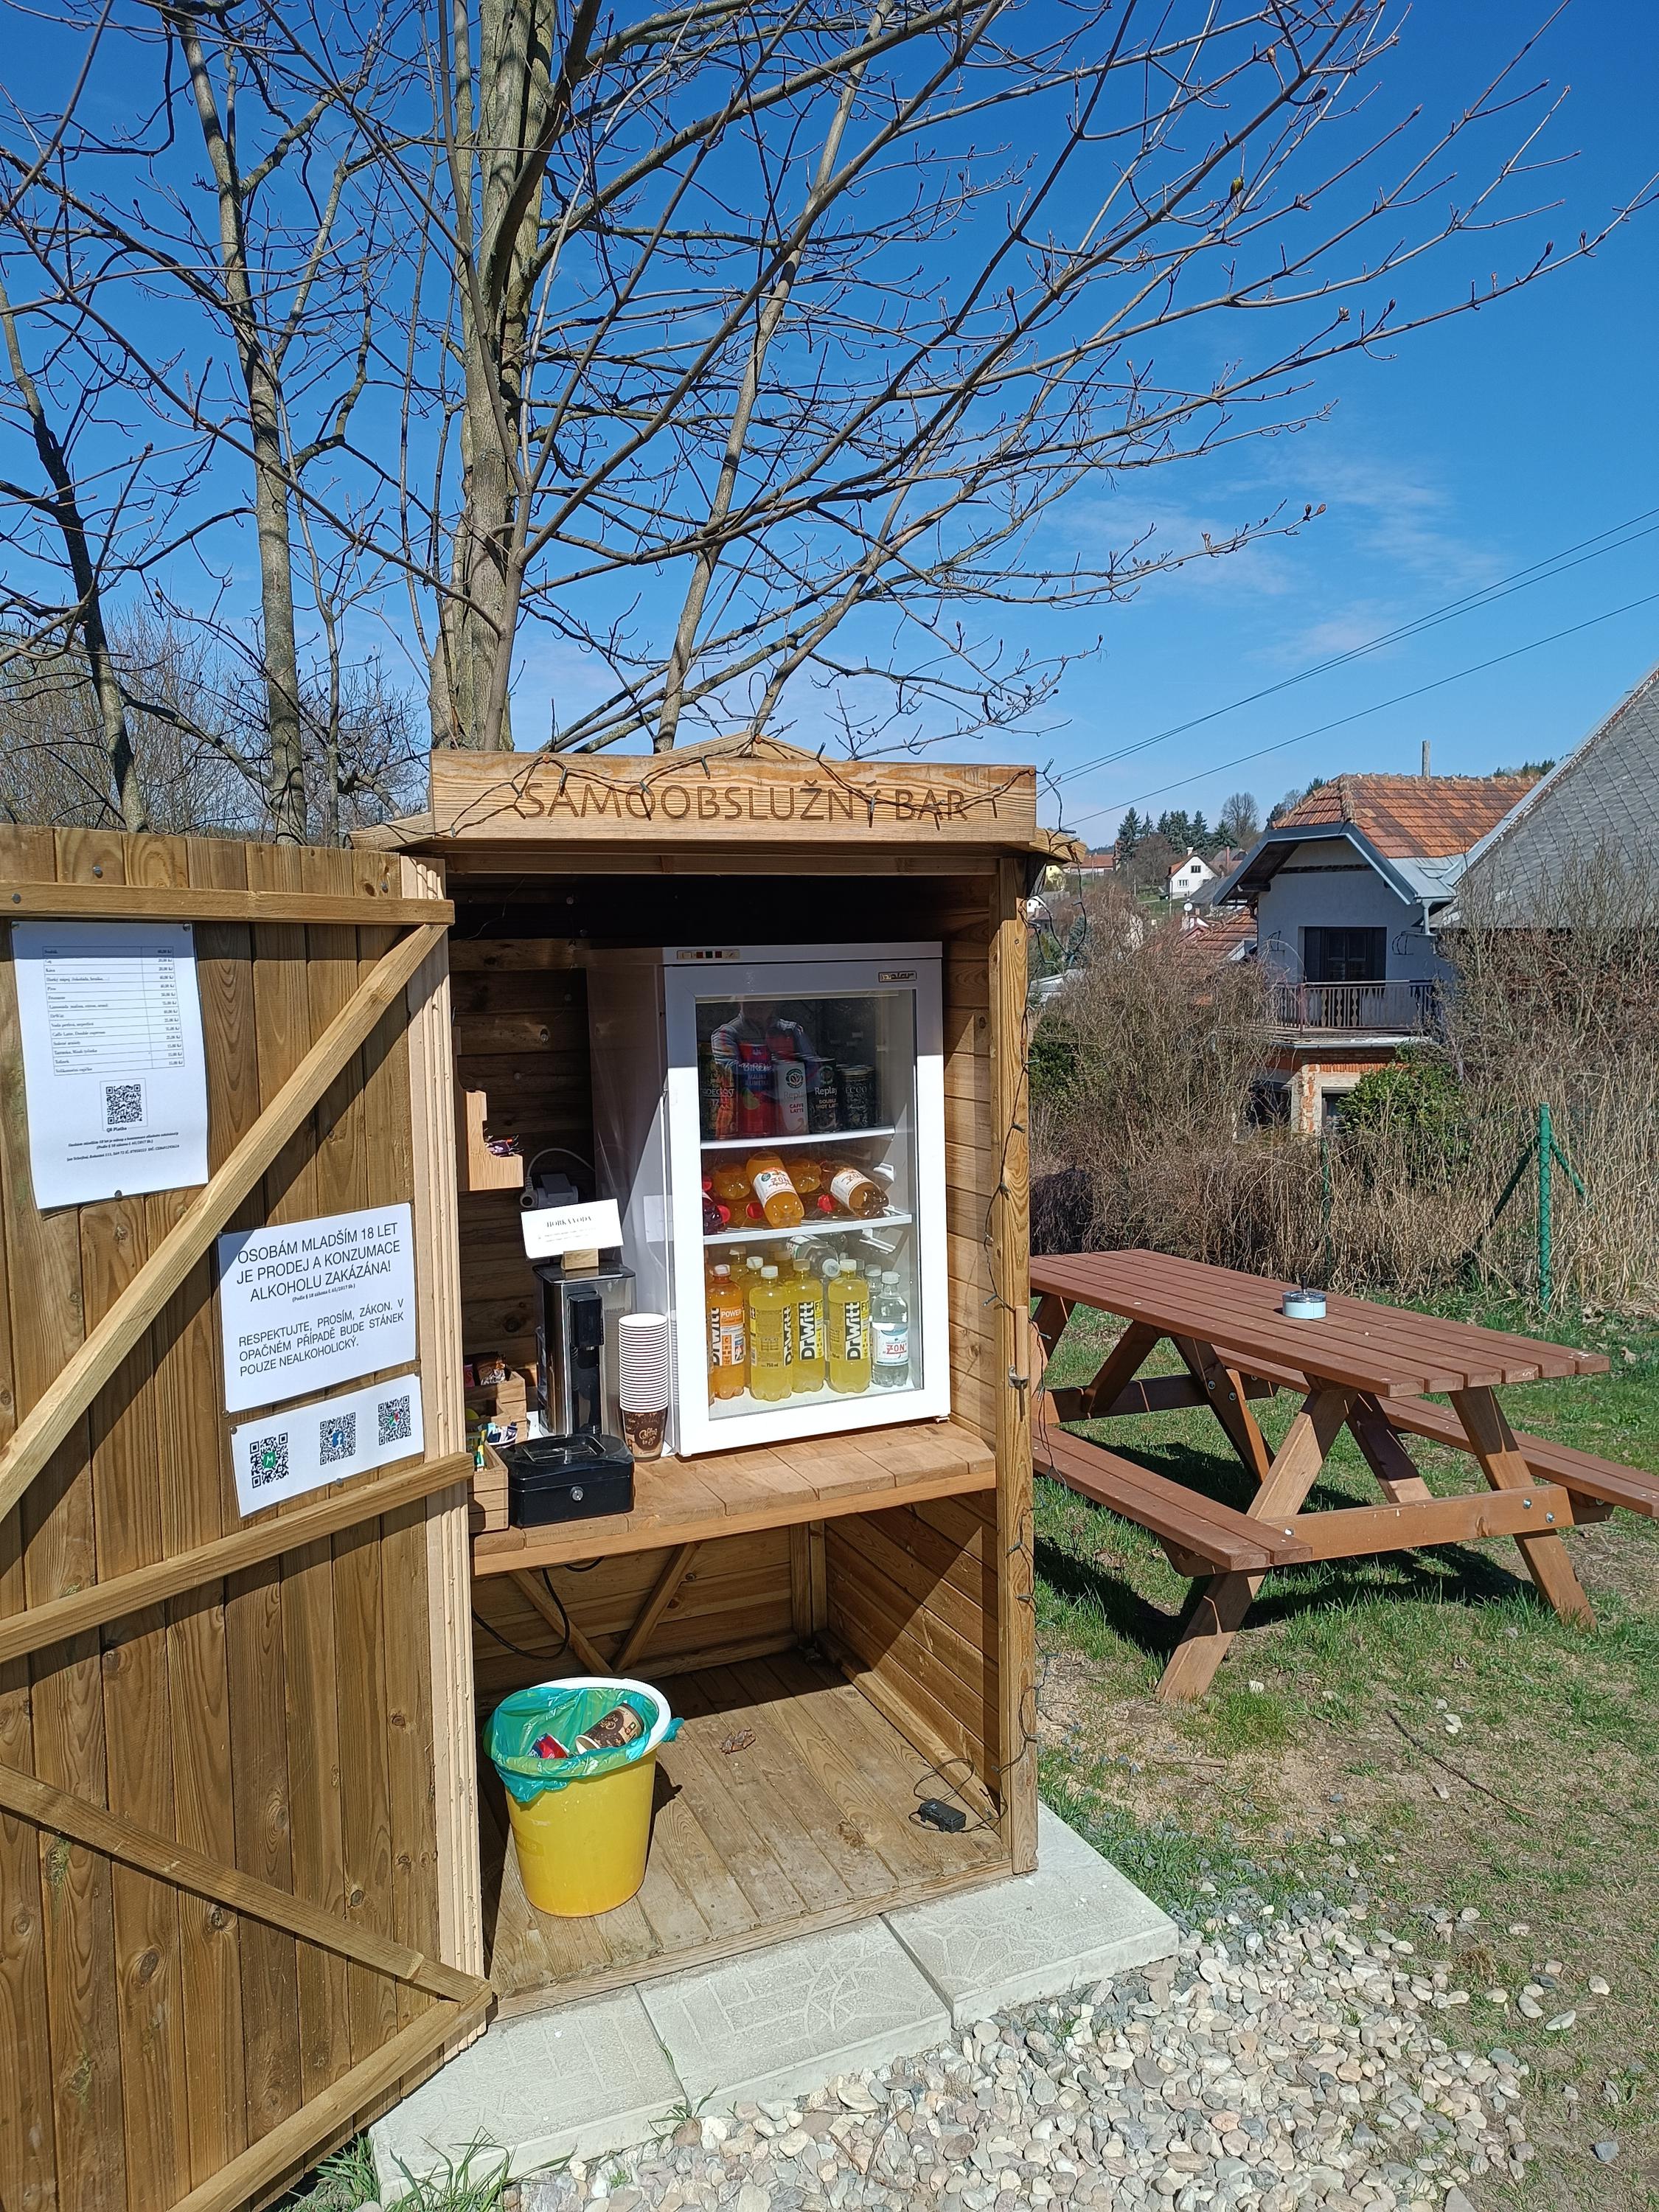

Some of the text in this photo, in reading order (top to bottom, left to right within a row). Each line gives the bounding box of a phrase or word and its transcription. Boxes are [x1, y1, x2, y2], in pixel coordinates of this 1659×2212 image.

[524, 779, 968, 822] SAMOOBSLUŽNÝ BAR
[237, 1222, 397, 1264] OSOBÁM MLADŠÍM 18 LET
[237, 1239, 400, 1284] JE PRODEJ A KONZUMACE
[250, 1260, 391, 1302] ALKOHOLU ZAKÁZÁNA!
[239, 1298, 403, 1347] RESPEKTUJTE, PROSÍM, ZÁKON. V
[239, 1311, 404, 1361] OPAČNÉM PŘÍPADĚ BUDE STÁNEK
[799, 1301, 815, 1360] DrWitt
[845, 1301, 861, 1360] DrWitt
[240, 1335, 359, 1377] POUZE NEALKOHOLICKÝ.
